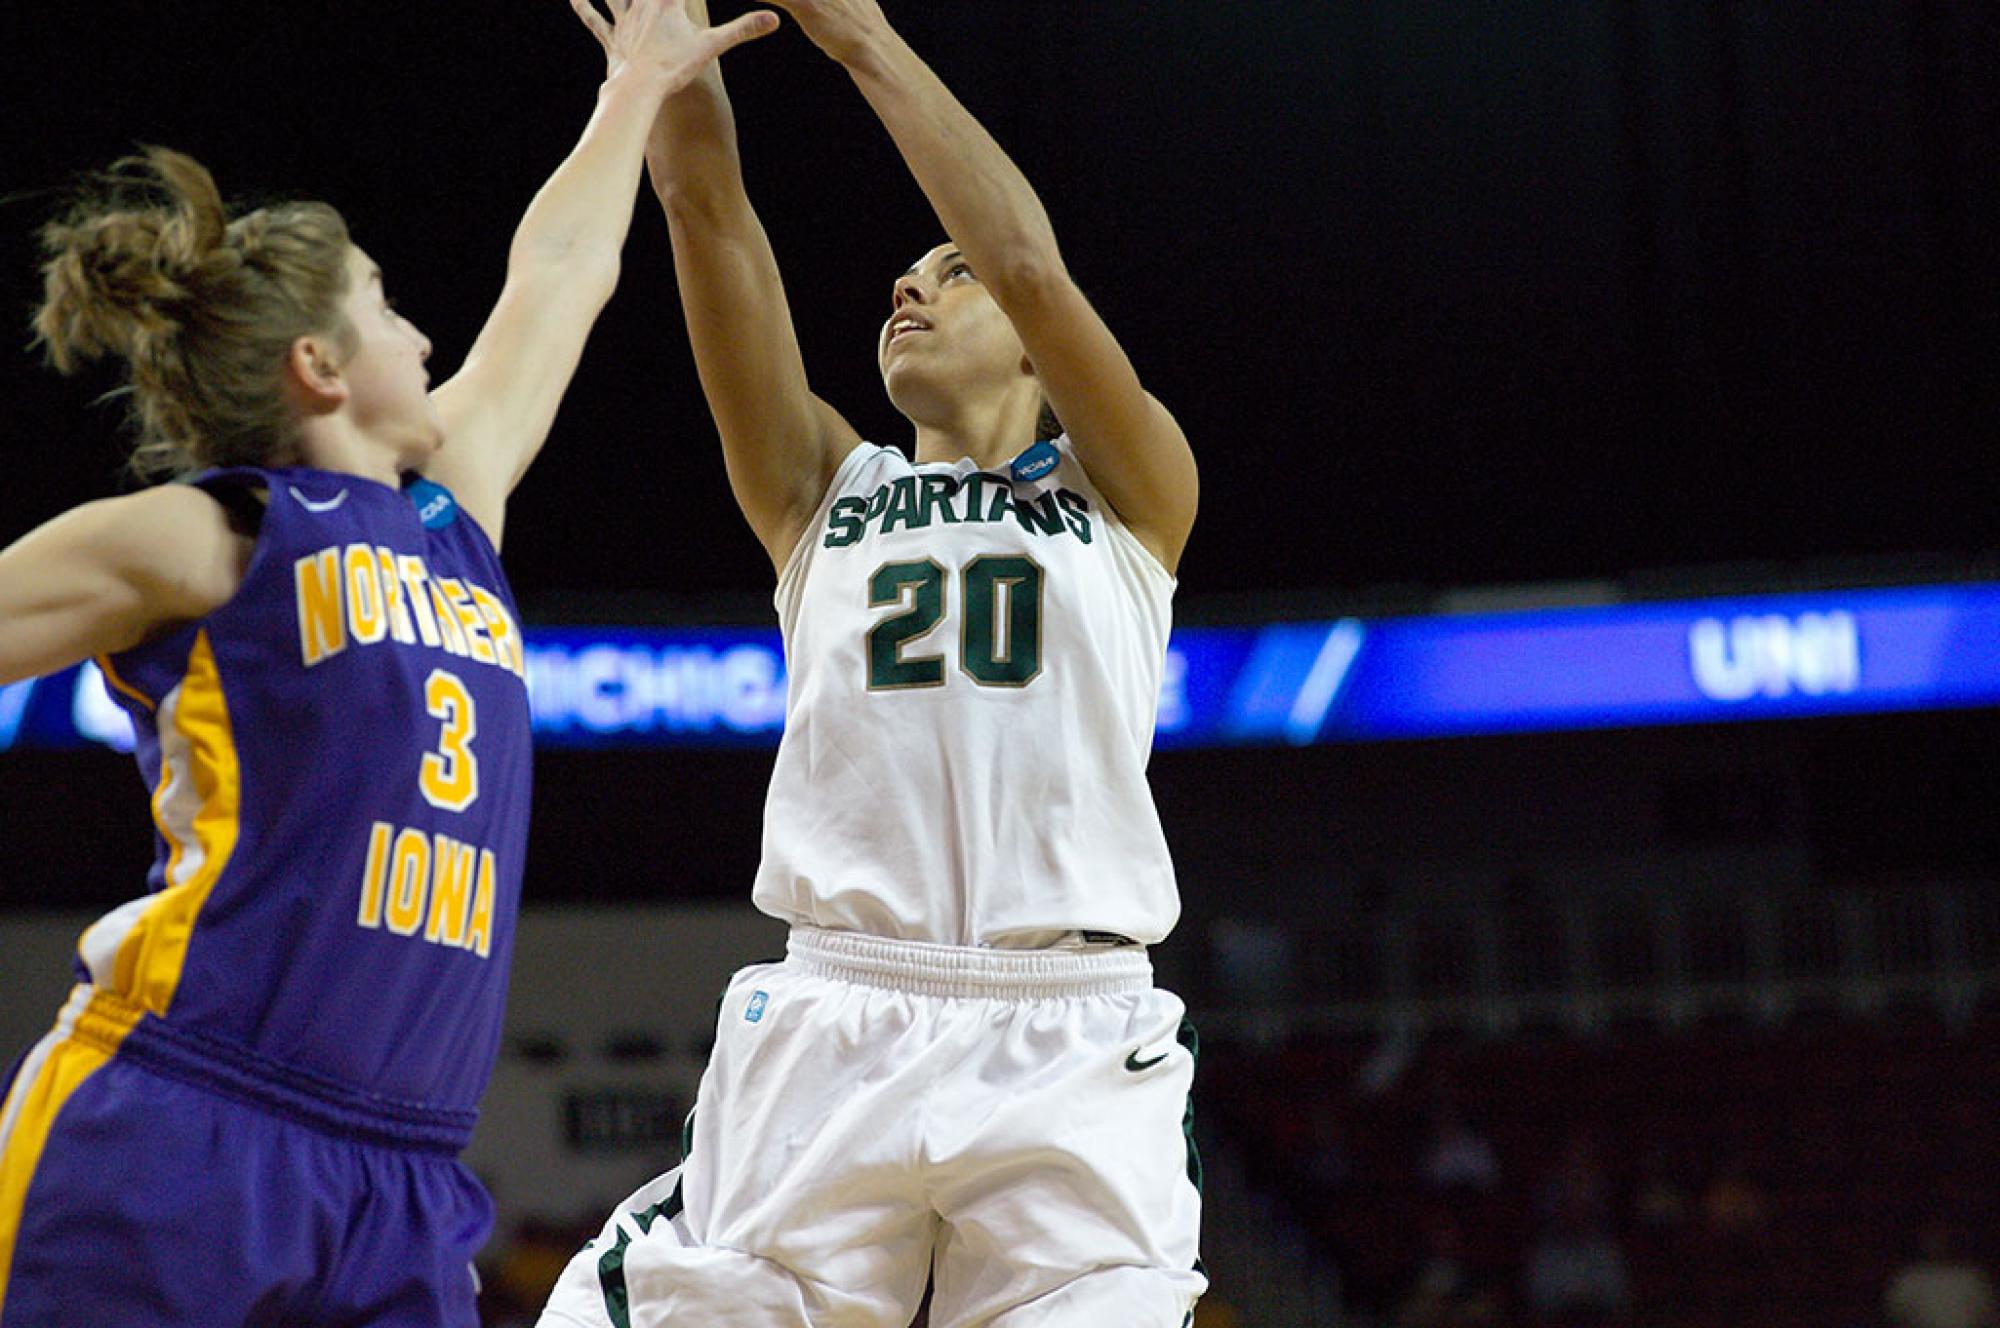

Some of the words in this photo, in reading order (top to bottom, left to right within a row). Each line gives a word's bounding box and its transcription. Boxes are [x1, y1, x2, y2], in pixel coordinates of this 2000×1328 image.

[823, 472, 1093, 549] SPARTANS
[866, 553, 1045, 692] 20
[1691, 611, 1860, 700] UNI
[418, 669, 478, 813] 3
[358, 820, 496, 958] IOWA
